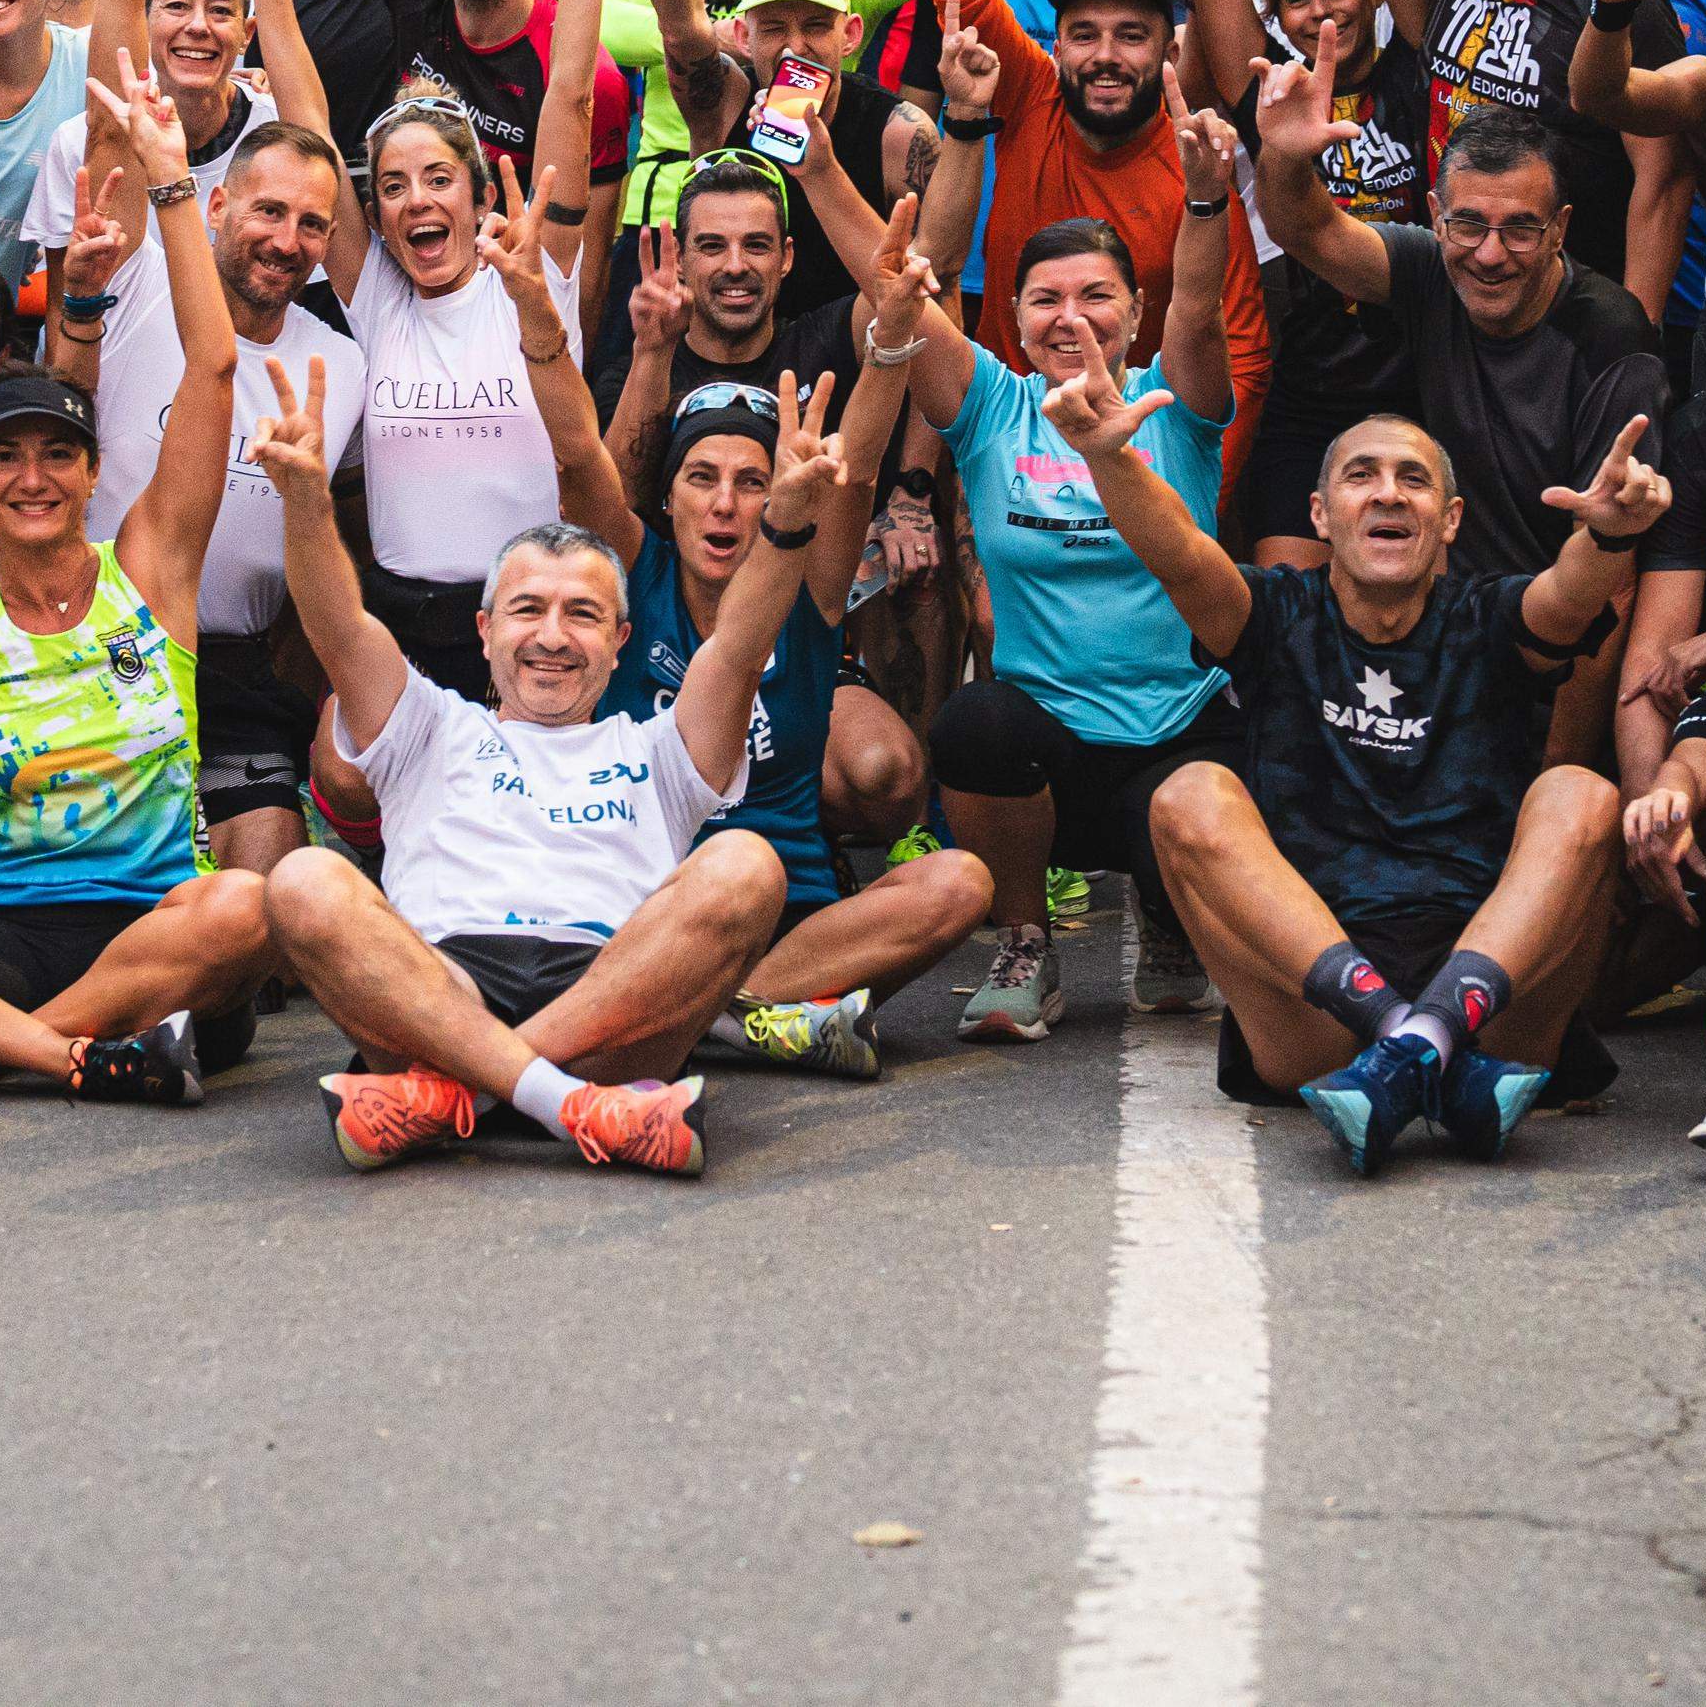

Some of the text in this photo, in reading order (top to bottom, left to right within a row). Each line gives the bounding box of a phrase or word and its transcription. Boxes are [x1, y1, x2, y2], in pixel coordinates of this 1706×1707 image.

[1430, 55, 1467, 85] XXIV
[1470, 76, 1540, 110] EDICIÓN
[373, 377, 521, 411] CUELLAR
[379, 425, 503, 441] STONE 1958
[1009, 514, 1025, 525] 16
[1034, 518, 1056, 531] DE
[589, 763, 650, 786] 2XU
